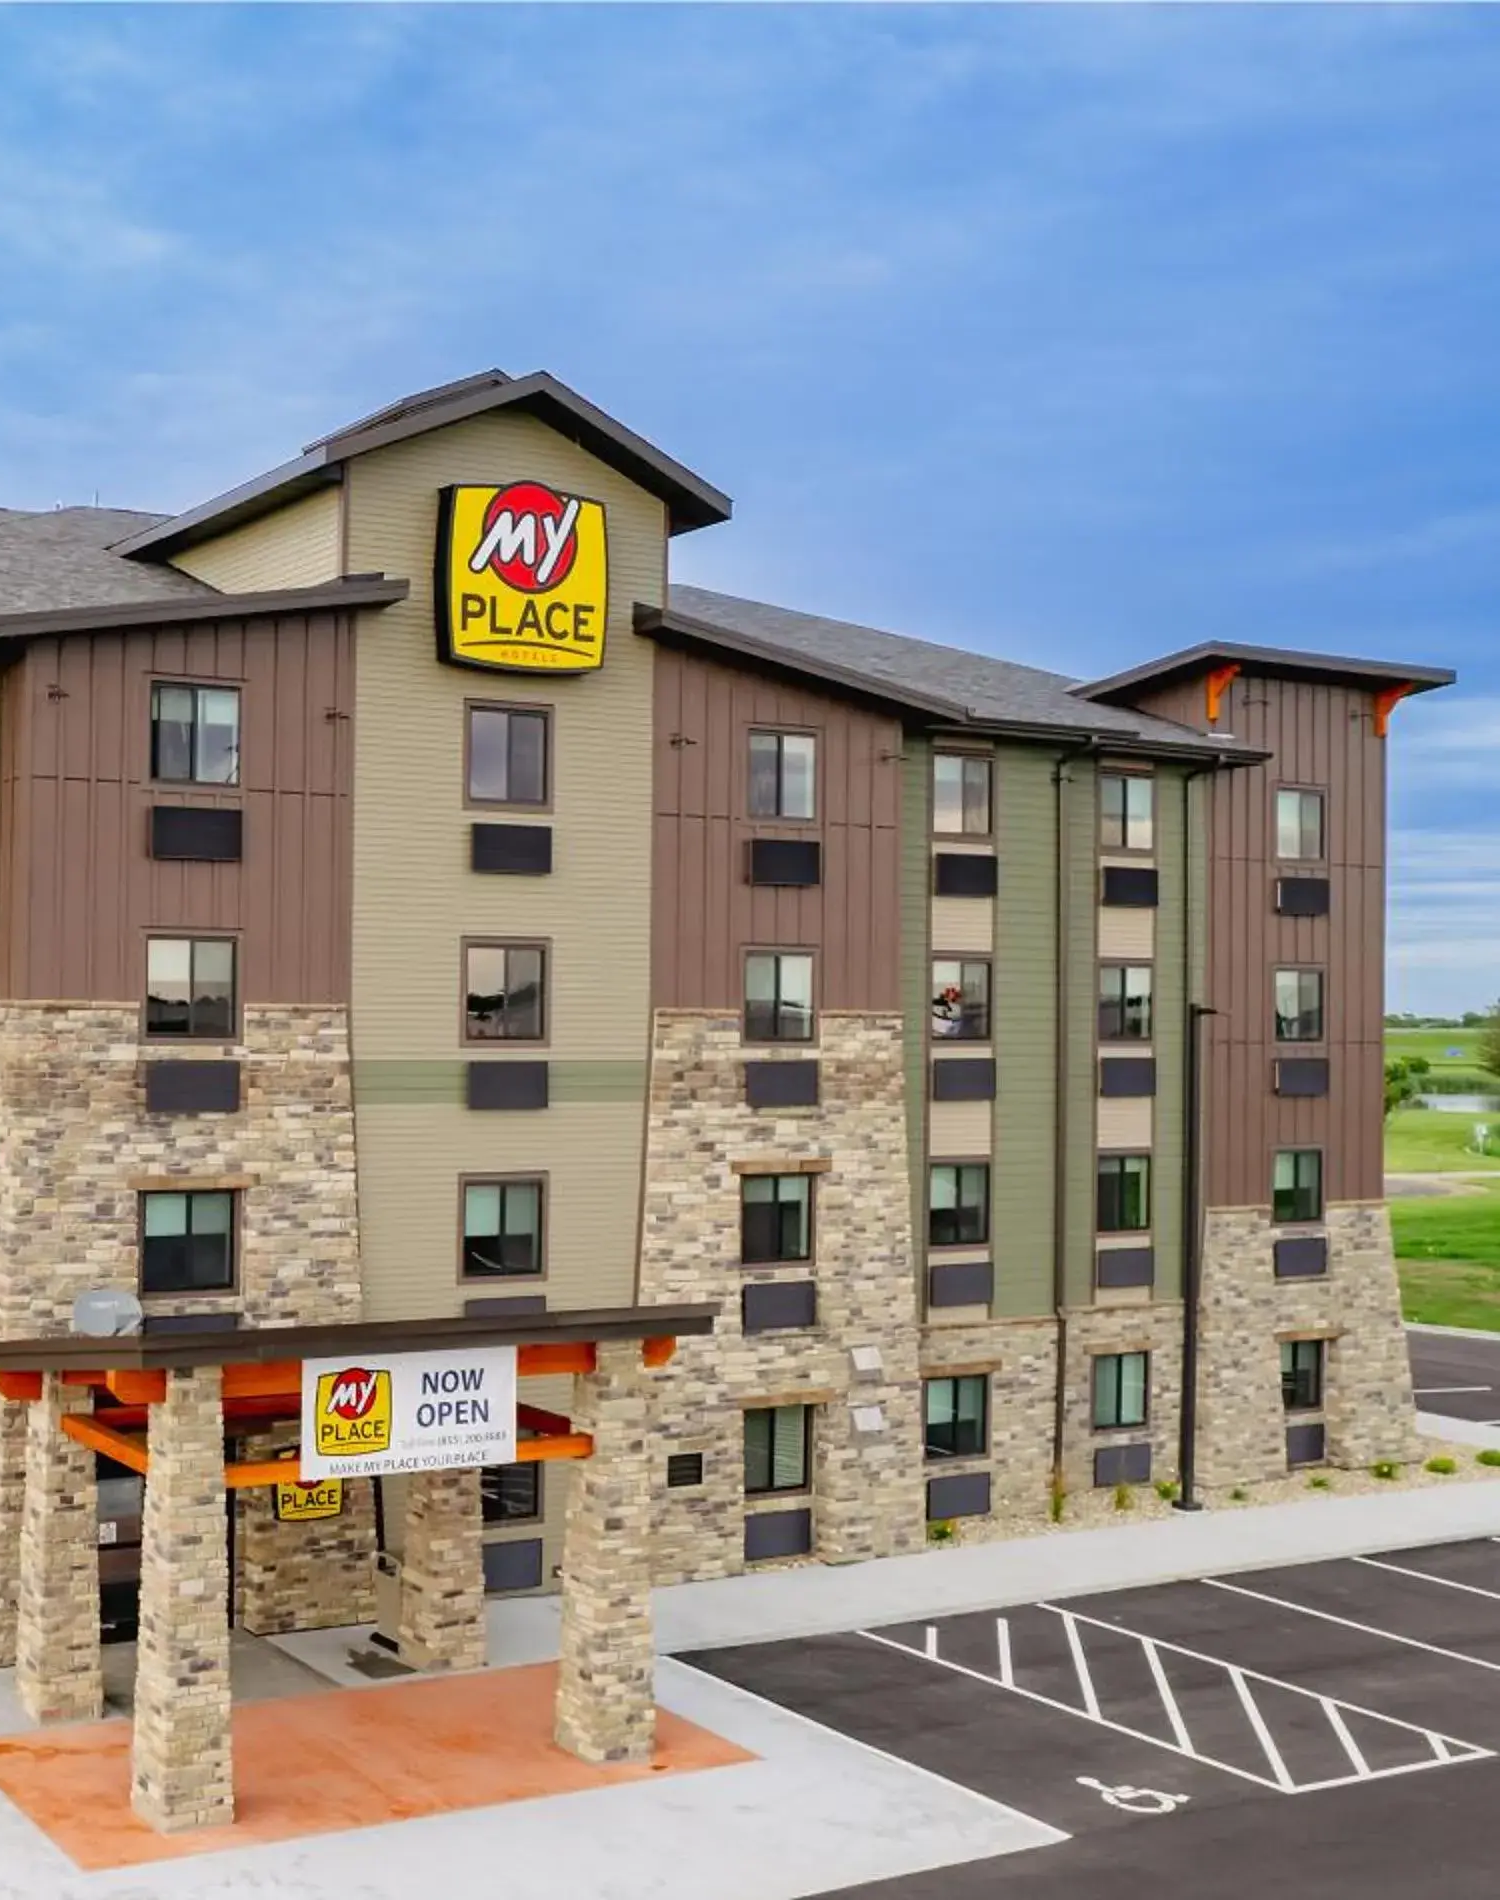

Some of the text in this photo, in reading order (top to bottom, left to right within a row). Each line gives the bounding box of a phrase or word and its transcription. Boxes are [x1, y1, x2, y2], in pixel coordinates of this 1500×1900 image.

[460, 593, 595, 643] PLACE
[422, 1367, 484, 1395] NOW
[416, 1398, 489, 1427] OPEN
[321, 1420, 385, 1442] PLACE
[329, 1450, 488, 1475] MAKE MY PLACE YOUR PLACE
[281, 1489, 338, 1510] PLACE
